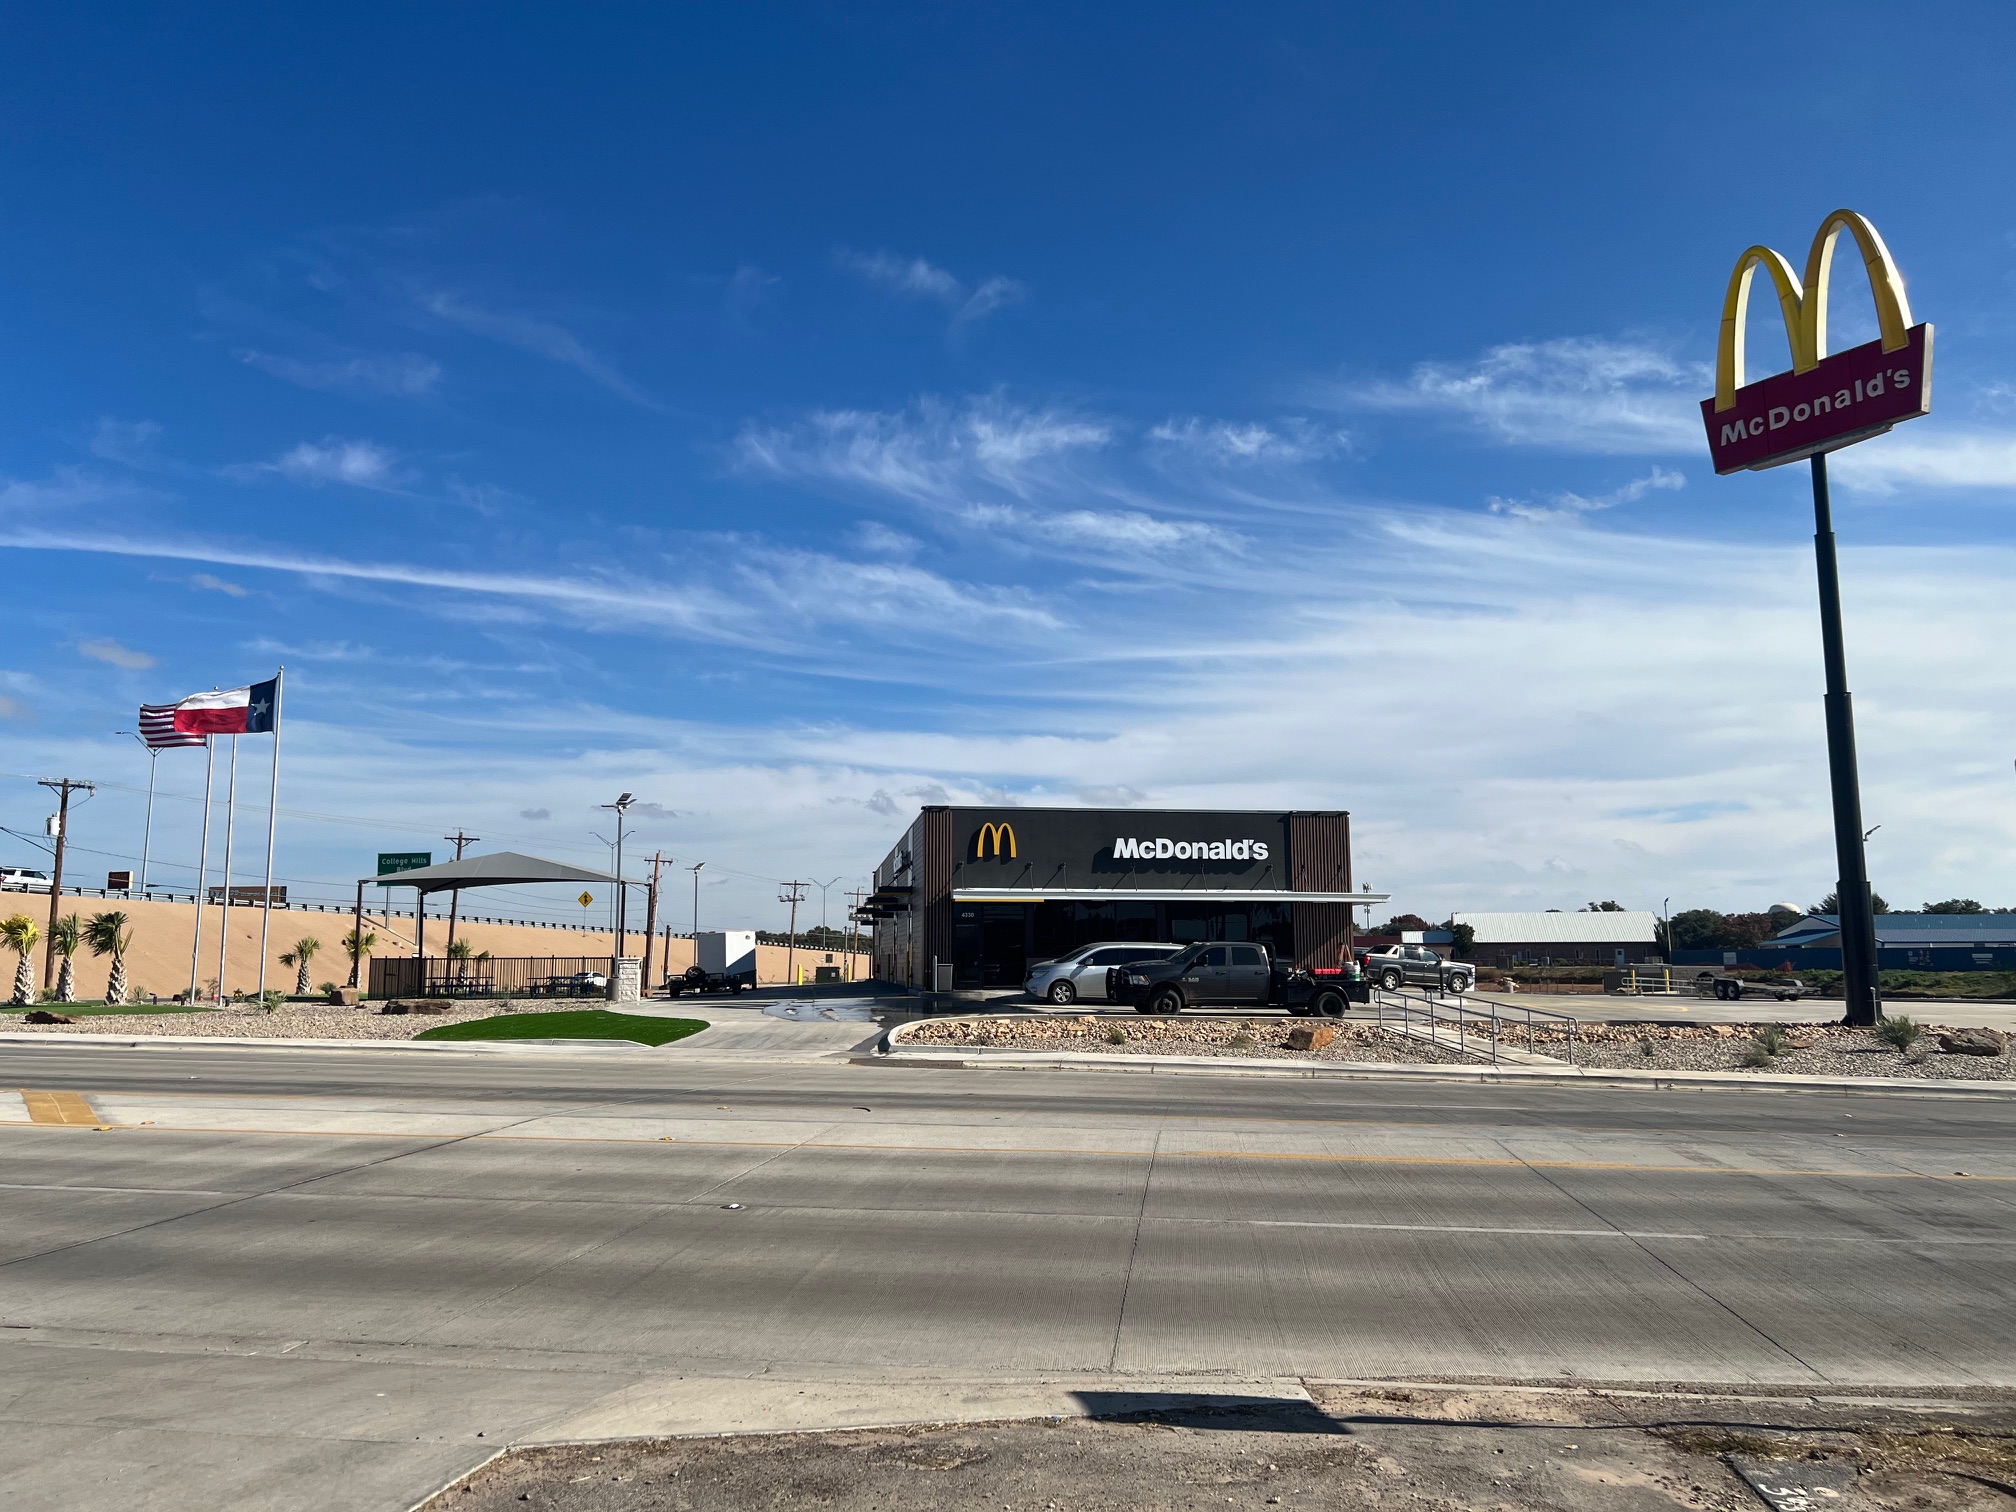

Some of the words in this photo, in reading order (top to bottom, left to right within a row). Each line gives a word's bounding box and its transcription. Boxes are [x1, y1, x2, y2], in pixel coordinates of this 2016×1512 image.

[1720, 368, 1911, 446] McDonald's
[1113, 837, 1269, 860] McDonald's
[381, 858, 409, 866] College
